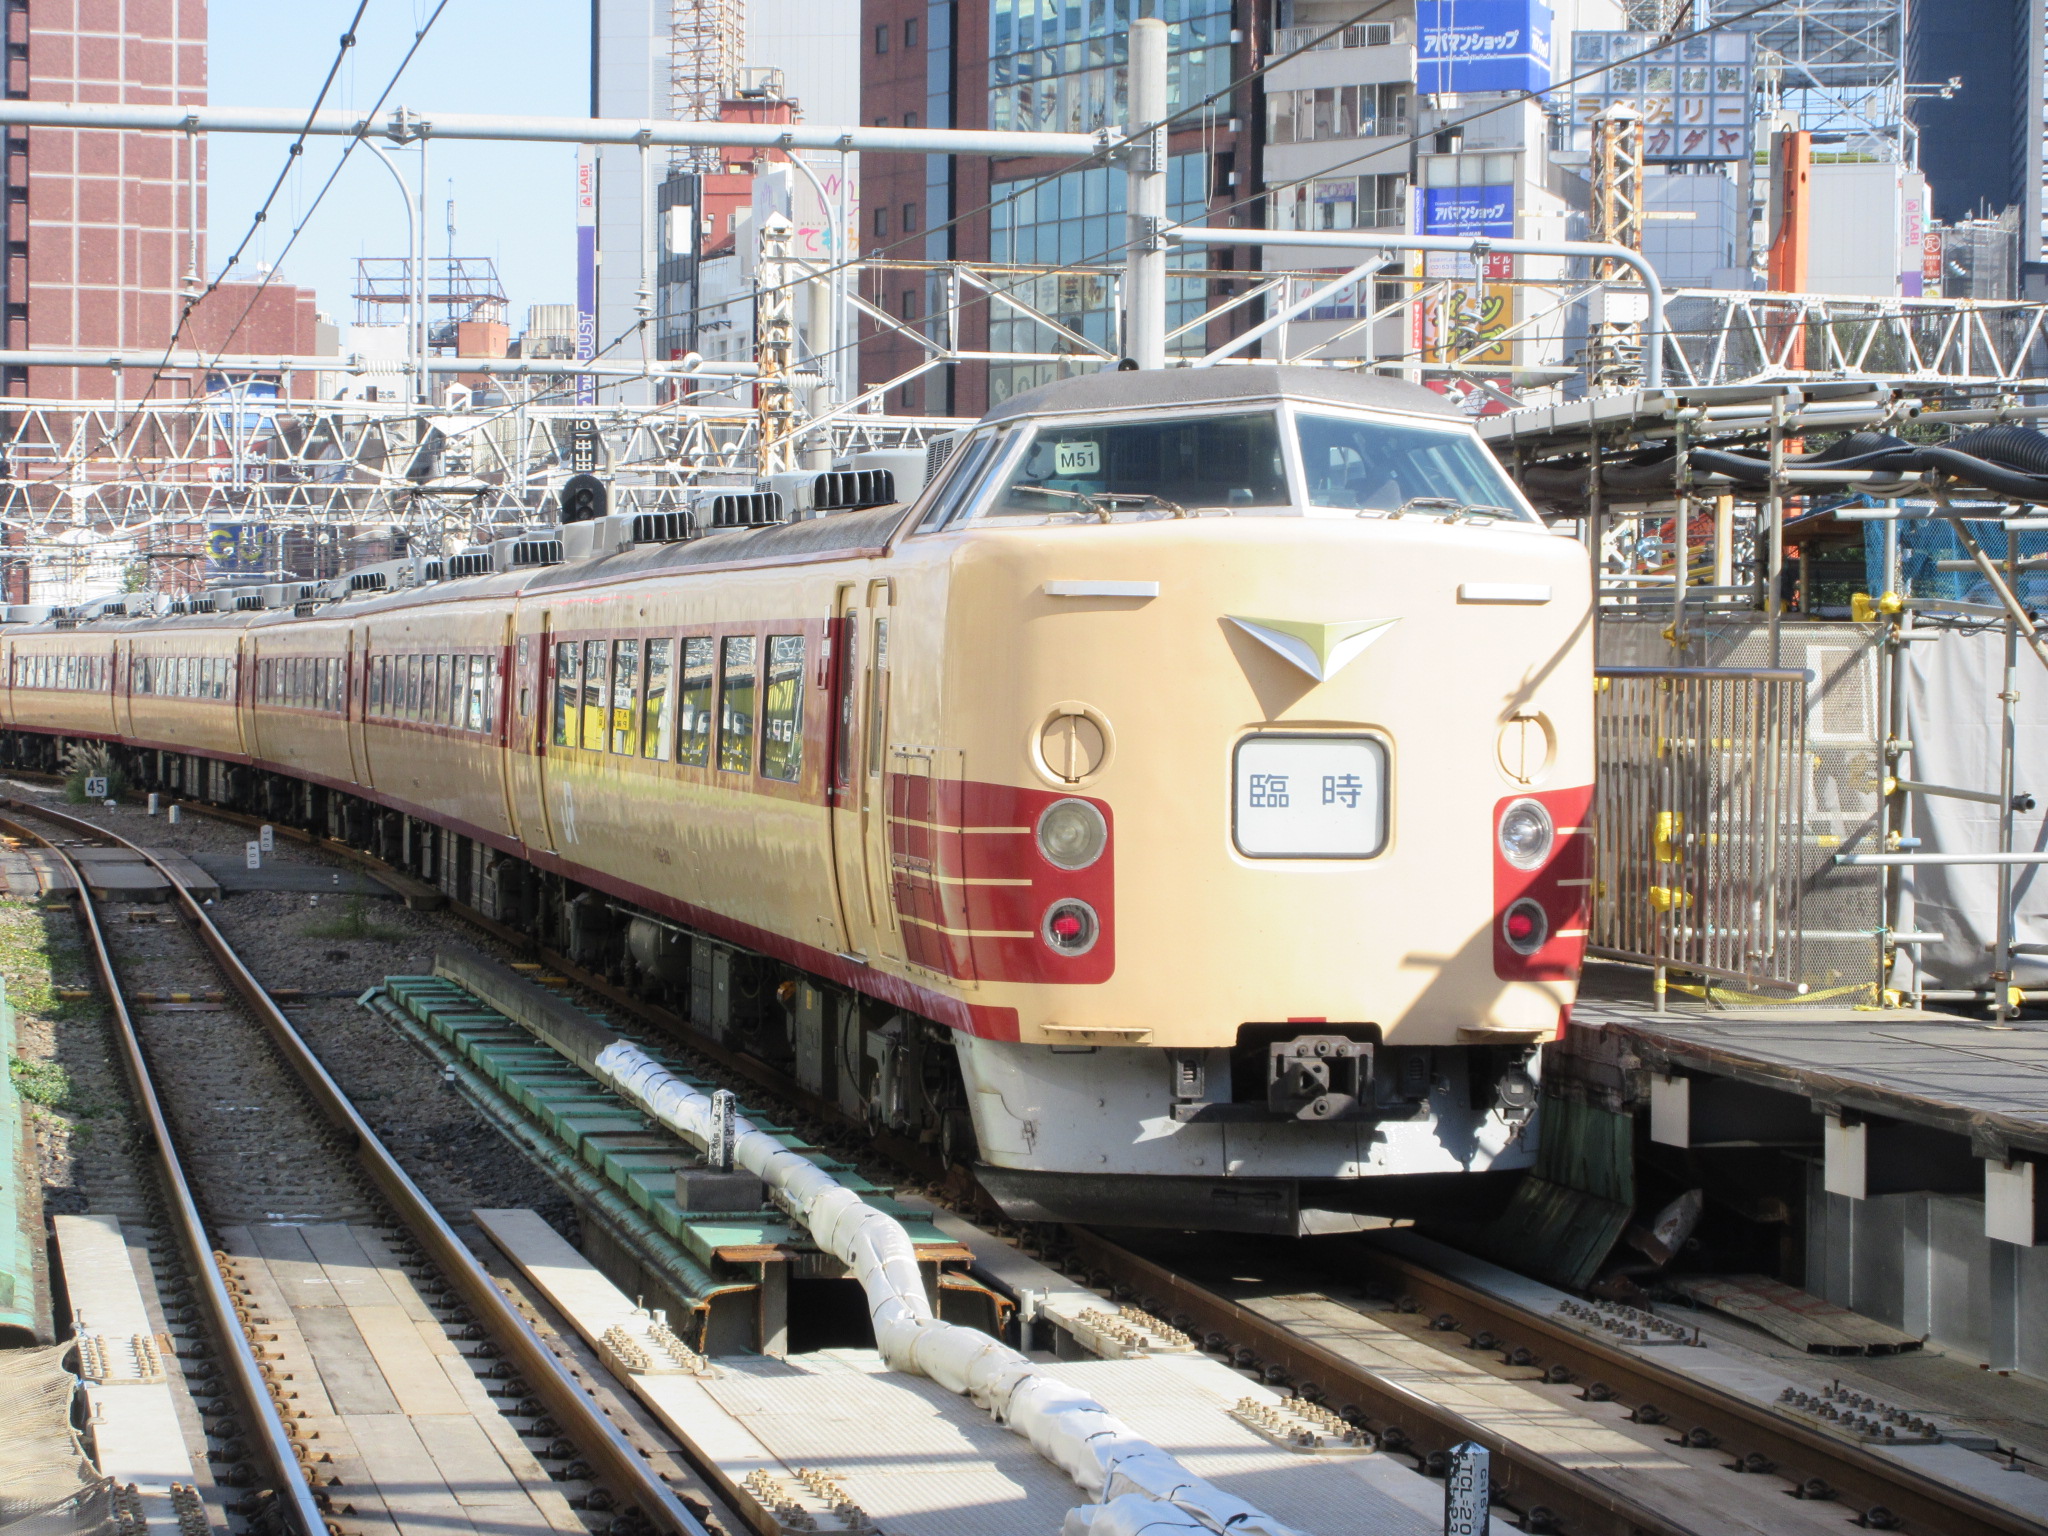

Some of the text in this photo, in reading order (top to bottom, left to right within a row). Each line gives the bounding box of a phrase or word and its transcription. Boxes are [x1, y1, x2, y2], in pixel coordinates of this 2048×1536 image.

[1424, 29, 1519, 53] アパマンショップ
[1613, 67, 1743, 91] 洋装材料
[580, 165, 588, 193] LABI
[1435, 203, 1505, 221] アパマンショップ
[1910, 215, 1919, 245] LABI
[1503, 265, 1510, 275] F
[577, 311, 594, 359] JUST
[1061, 452, 1094, 468] M51
[87, 780, 104, 794] 45
[1250, 774, 1363, 808] 臨時
[561, 781, 579, 845] JR
